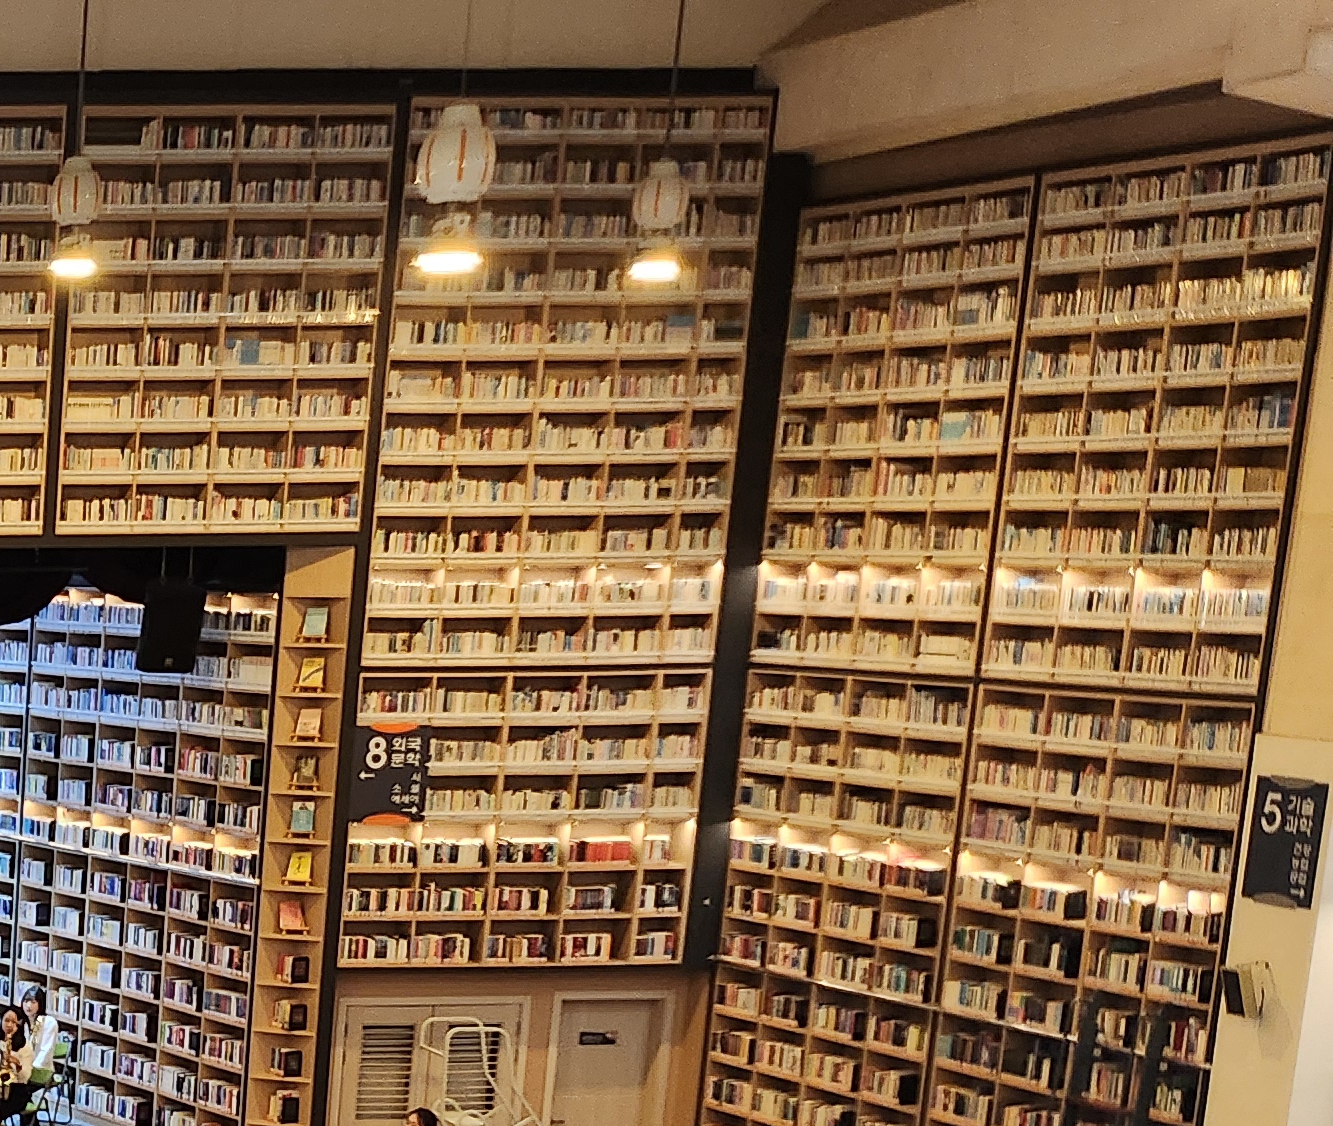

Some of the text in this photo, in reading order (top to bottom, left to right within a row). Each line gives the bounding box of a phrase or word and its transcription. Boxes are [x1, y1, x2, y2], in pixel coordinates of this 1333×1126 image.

[366, 736, 388, 770] 8
[1260, 790, 1283, 835] 5
[1287, 795, 1314, 817] 기술
[1284, 815, 1313, 838] 과학
